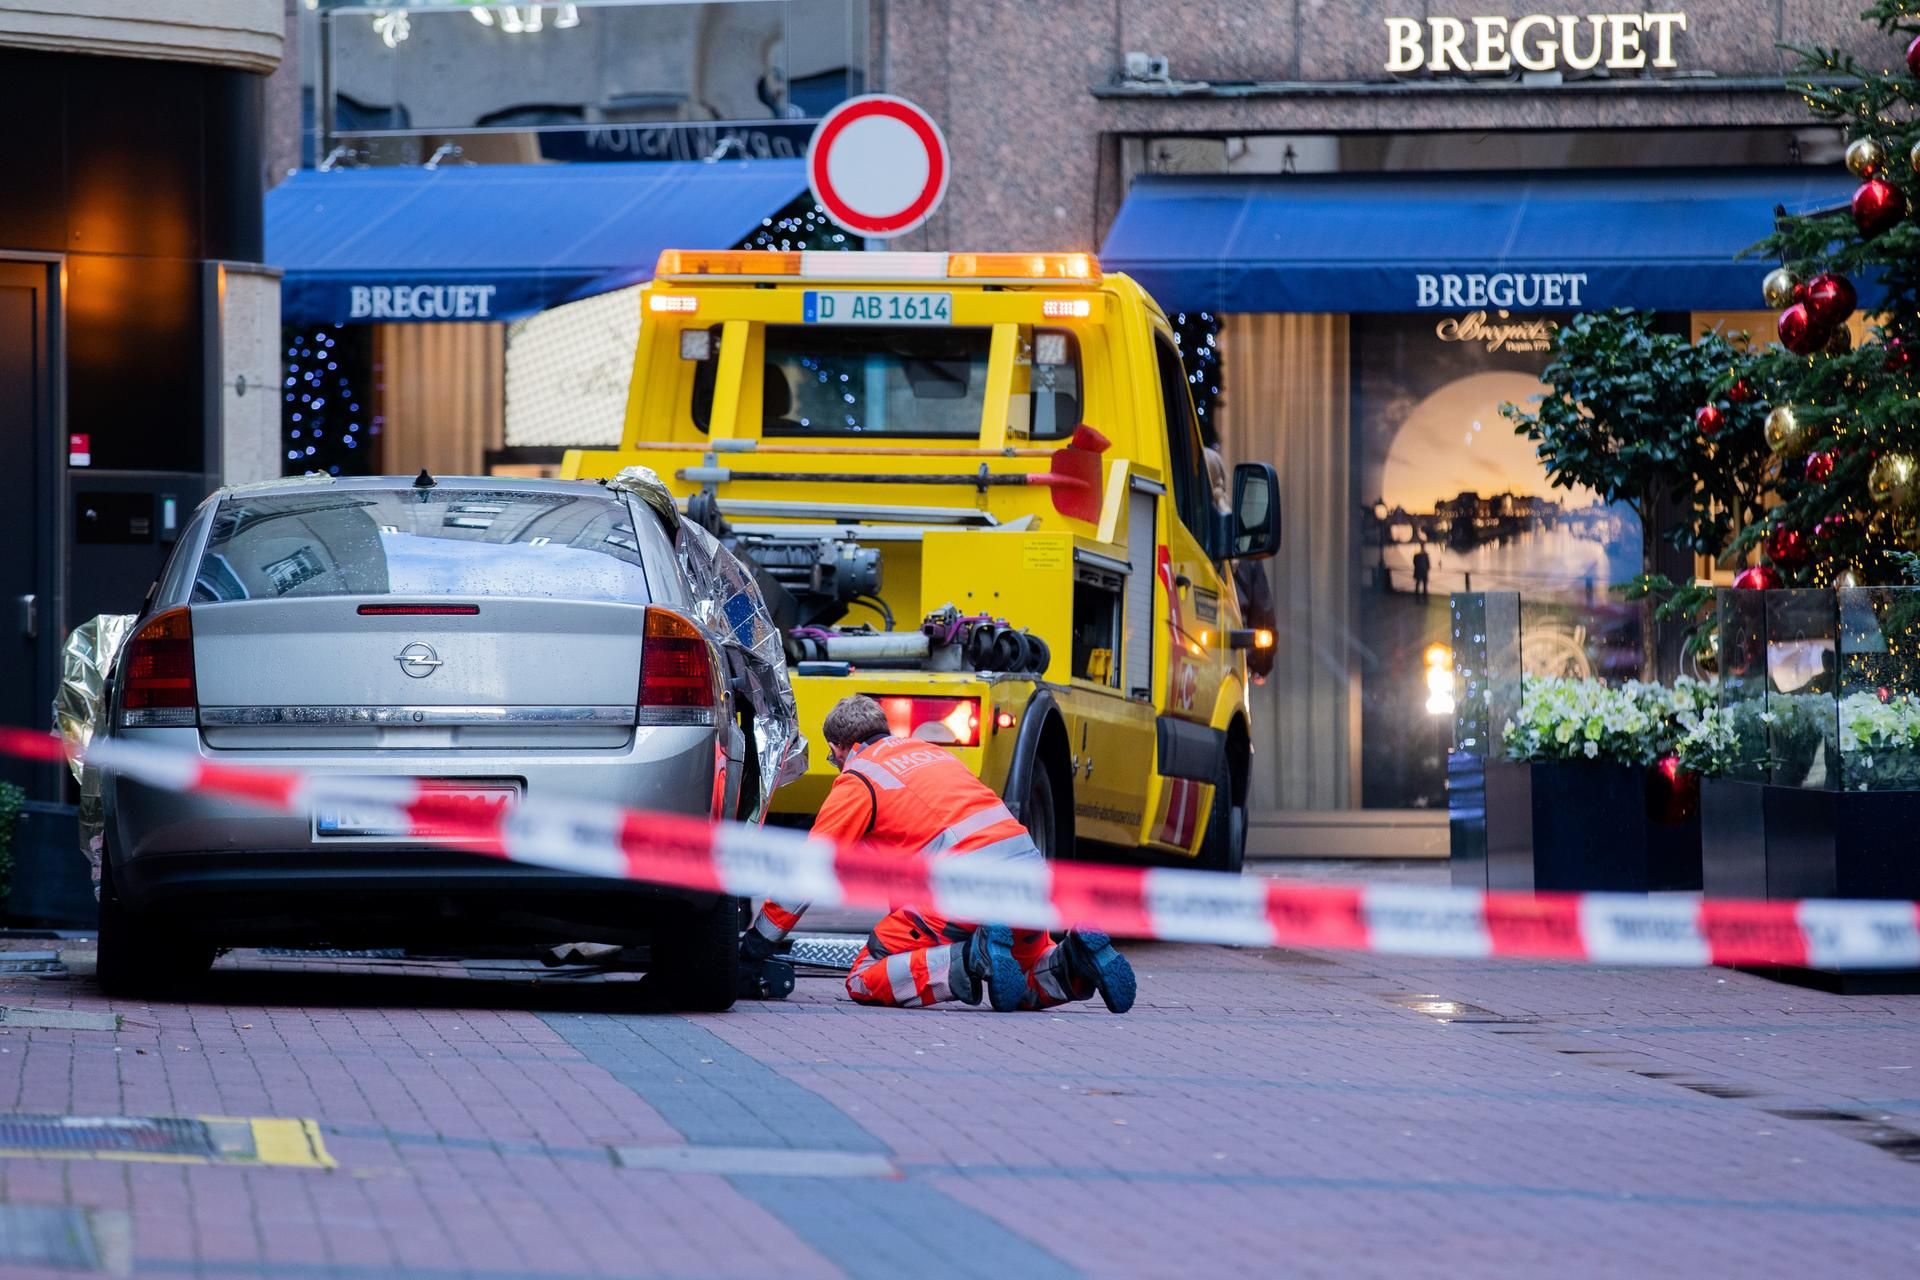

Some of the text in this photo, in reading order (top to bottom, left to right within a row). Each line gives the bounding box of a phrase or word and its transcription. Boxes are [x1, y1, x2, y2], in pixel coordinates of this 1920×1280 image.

[1384, 11, 1687, 72] BREGUET
[350, 284, 496, 318] BREGUET
[1416, 272, 1588, 307] BREGUET
[820, 295, 835, 318] D
[852, 296, 882, 319] AB
[889, 296, 947, 320] 1614
